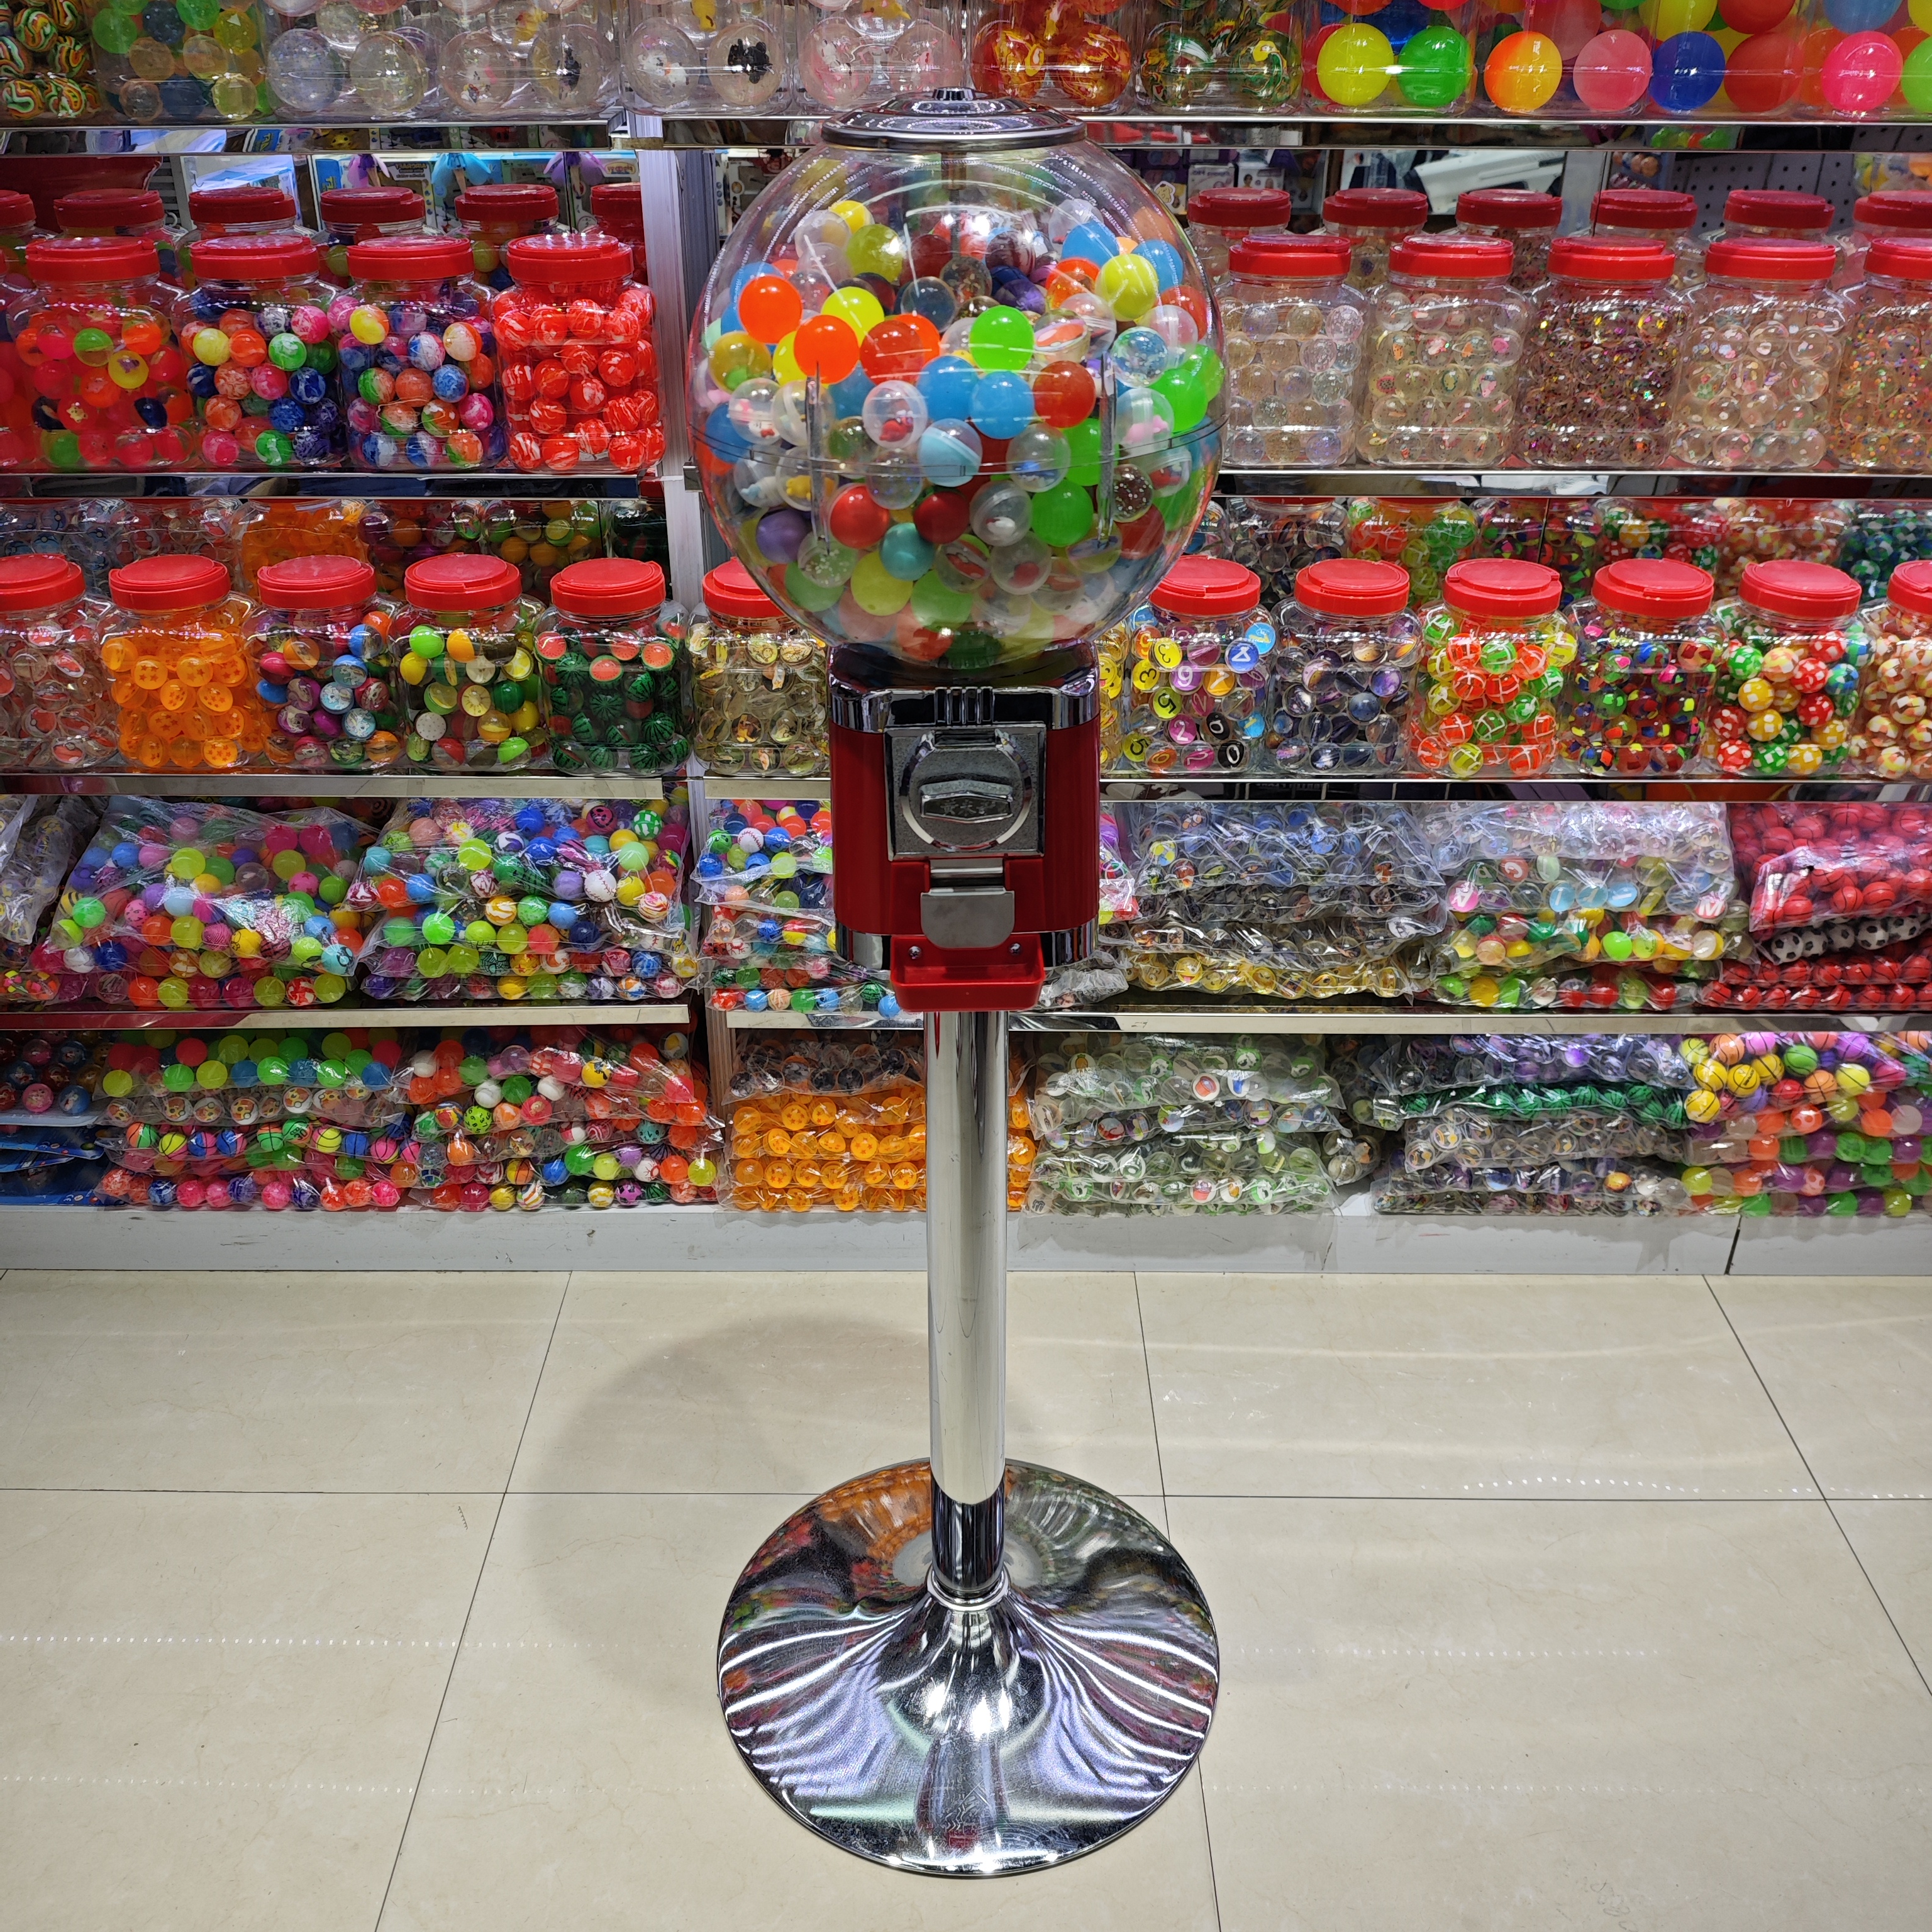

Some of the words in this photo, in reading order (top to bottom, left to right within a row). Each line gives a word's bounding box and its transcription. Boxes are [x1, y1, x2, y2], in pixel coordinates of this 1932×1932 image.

[1158, 643, 1171, 663] 3
[1139, 669, 1157, 684] 3
[1177, 665, 1193, 687] 9
[1158, 693, 1177, 714] 5
[1174, 719, 1189, 741] 2
[1699, 899, 1724, 916] M
